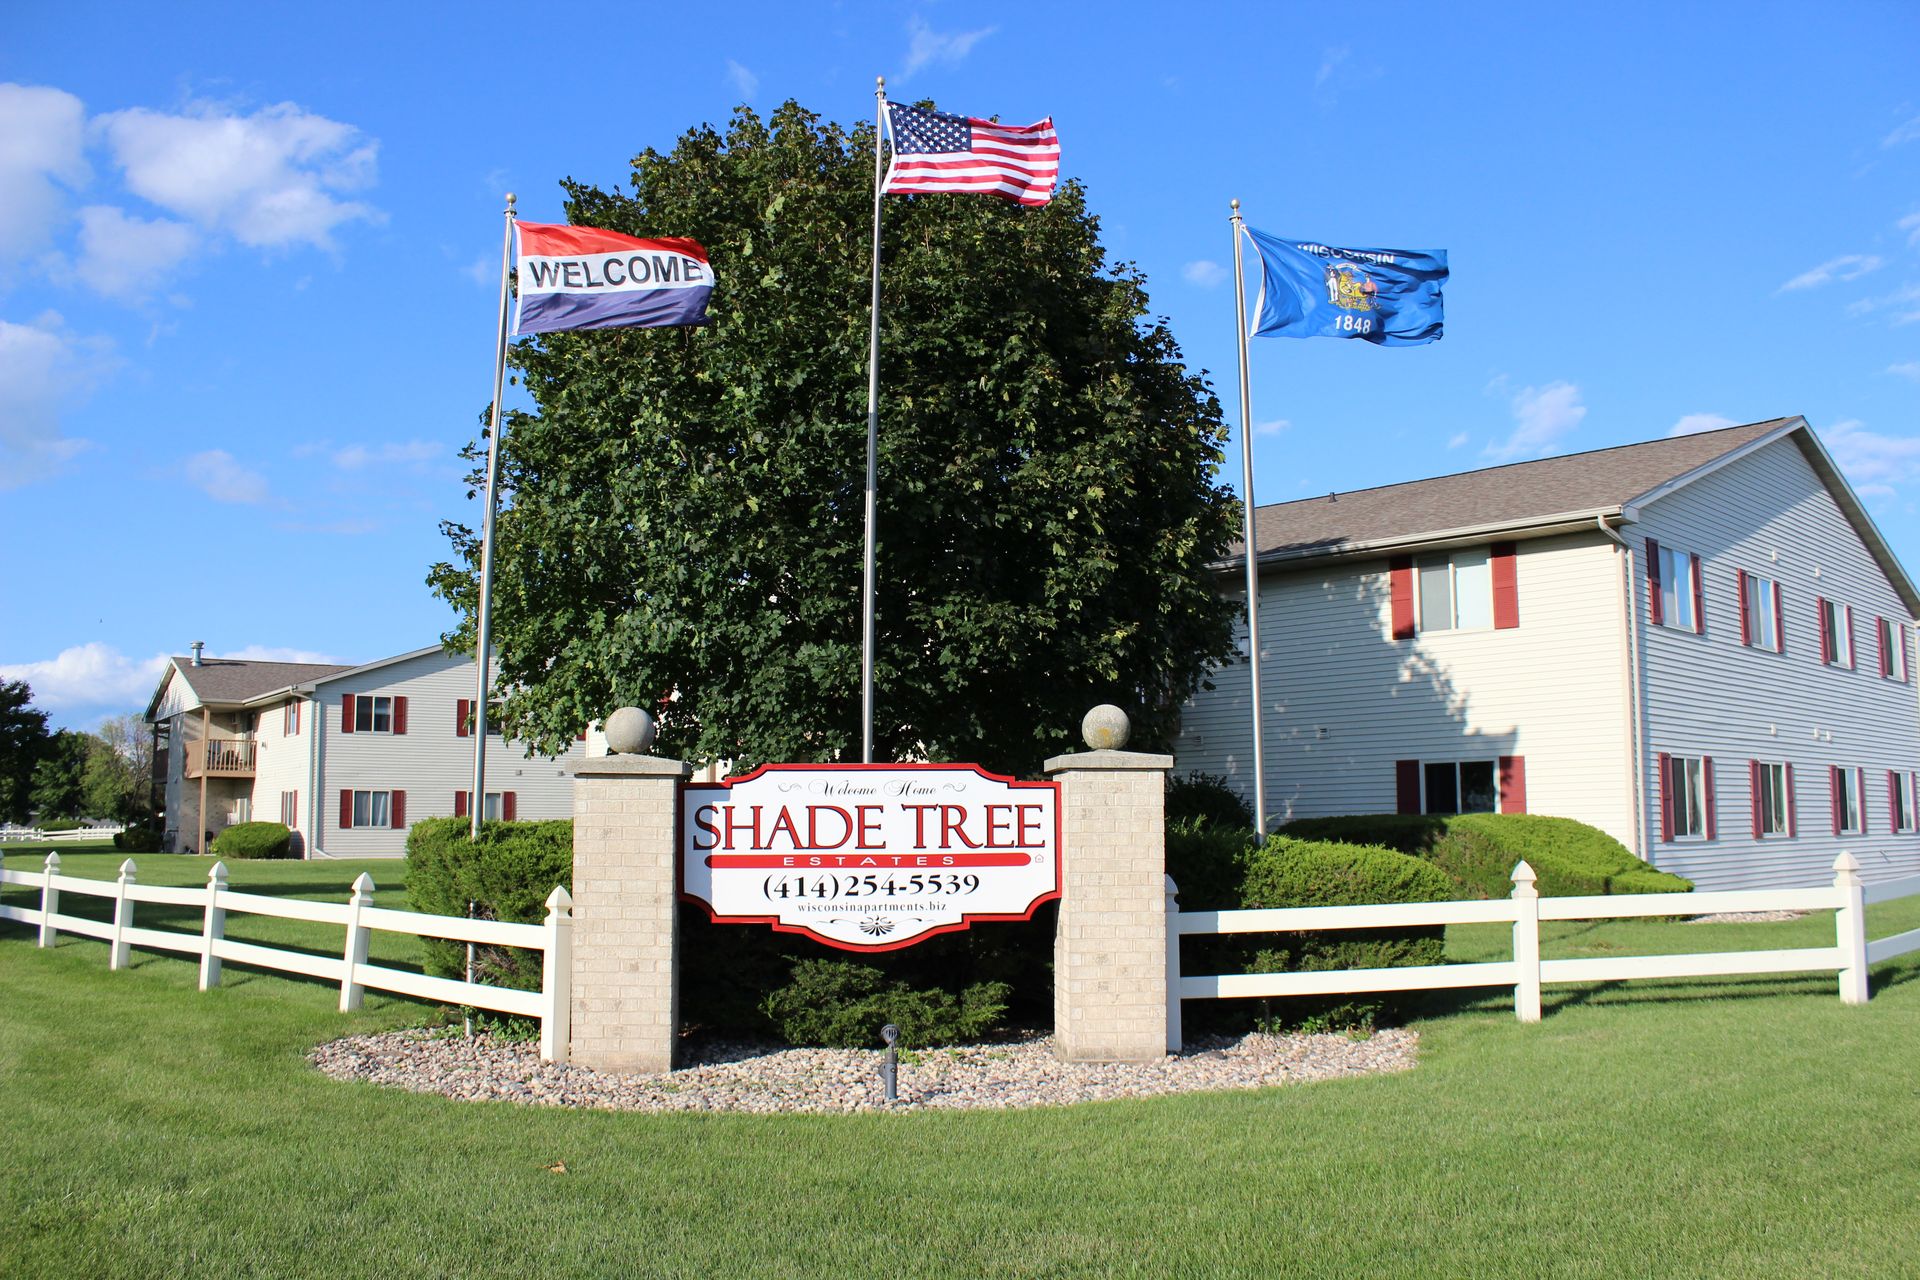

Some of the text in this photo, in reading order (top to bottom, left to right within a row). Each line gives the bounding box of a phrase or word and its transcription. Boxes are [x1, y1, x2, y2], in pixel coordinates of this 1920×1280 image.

[529, 255, 703, 288] WELCOME
[1334, 315, 1371, 334] 1848
[808, 779, 937, 797] Welcome Home
[693, 803, 1045, 850] SHADE TREE
[783, 855, 955, 867] ESTATES
[797, 901, 947, 913] wisconsinapartments.biz
